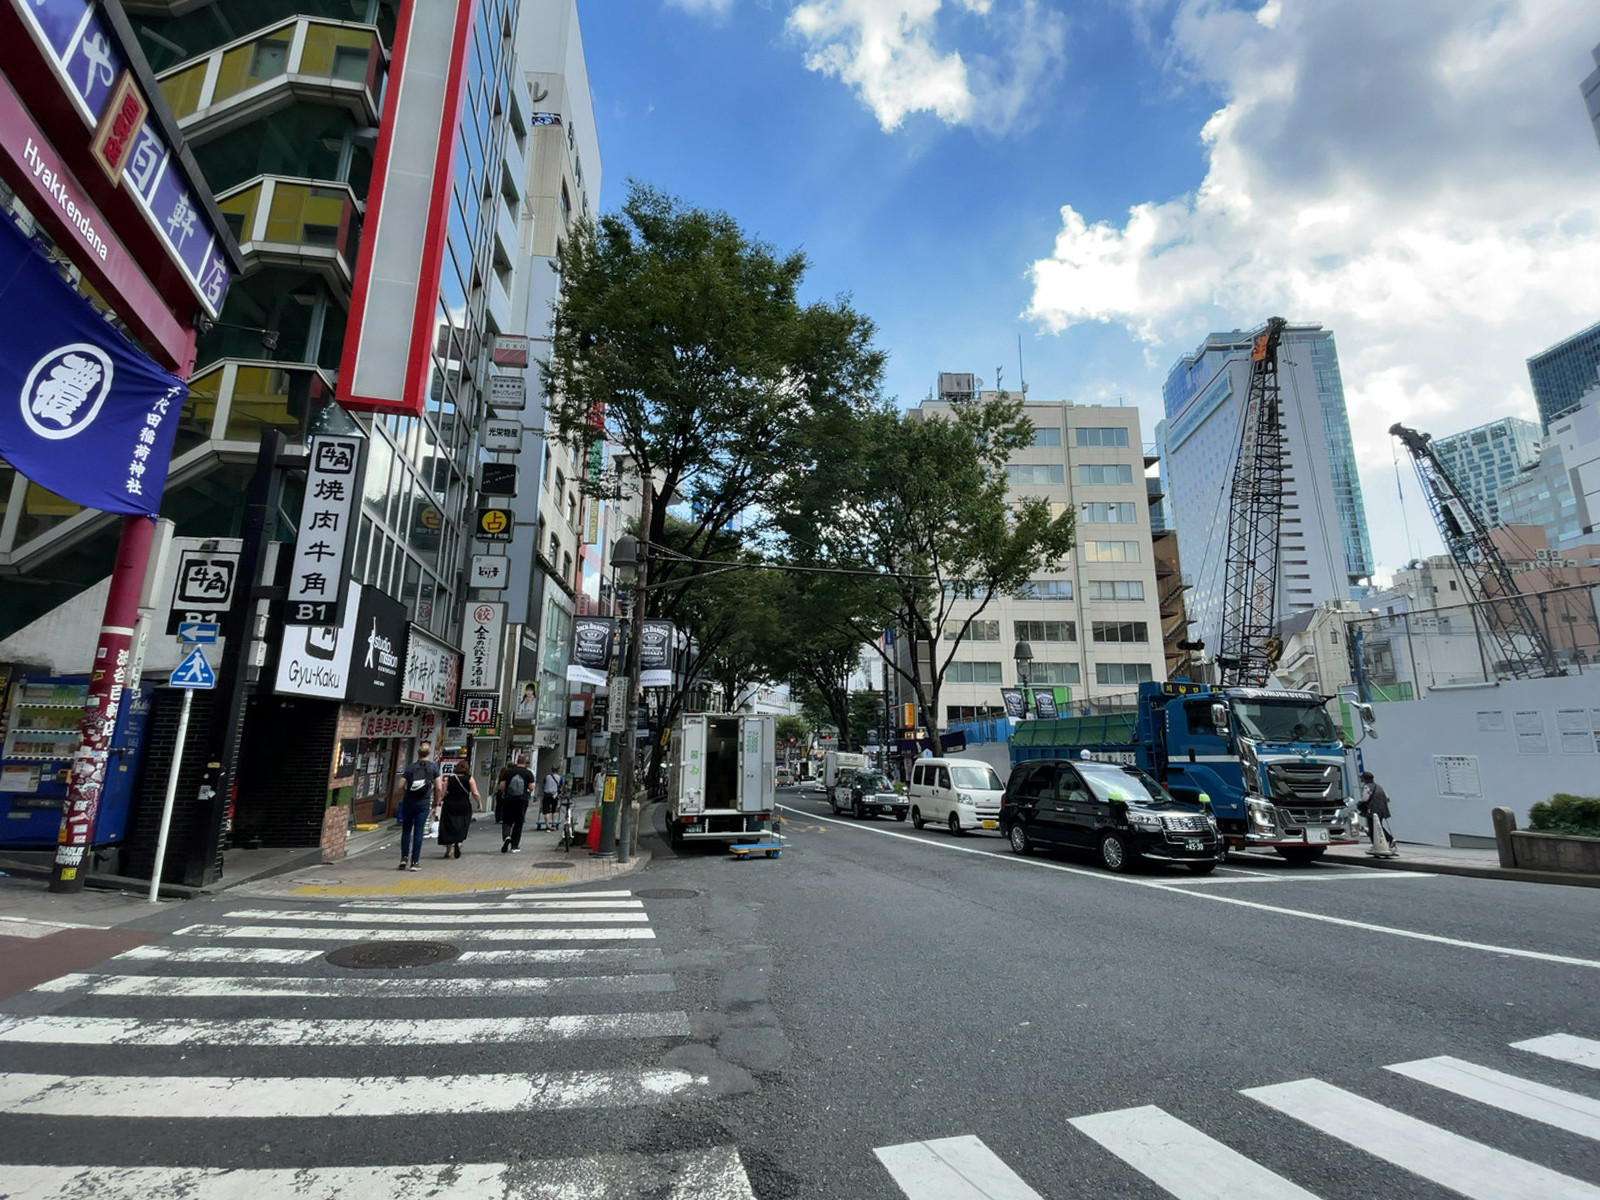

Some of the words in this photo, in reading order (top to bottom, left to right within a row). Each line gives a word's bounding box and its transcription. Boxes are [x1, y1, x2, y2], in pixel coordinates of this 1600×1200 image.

[23, 137, 109, 262] Hyakkendana
[126, 385, 182, 496] 千代田稲荷神社
[488, 427, 518, 438] 光栄物産
[321, 447, 350, 468] 牛角
[486, 512, 503, 531] 占
[299, 478, 345, 596] 焼肉牛角
[189, 567, 226, 594] 牛角
[296, 603, 327, 621] B1
[576, 624, 590, 633] JACK
[373, 635, 392, 654] studio
[470, 625, 490, 687] 金の餃子酒場
[288, 660, 341, 689] Gyu-Kaku
[468, 708, 489, 722] 50
